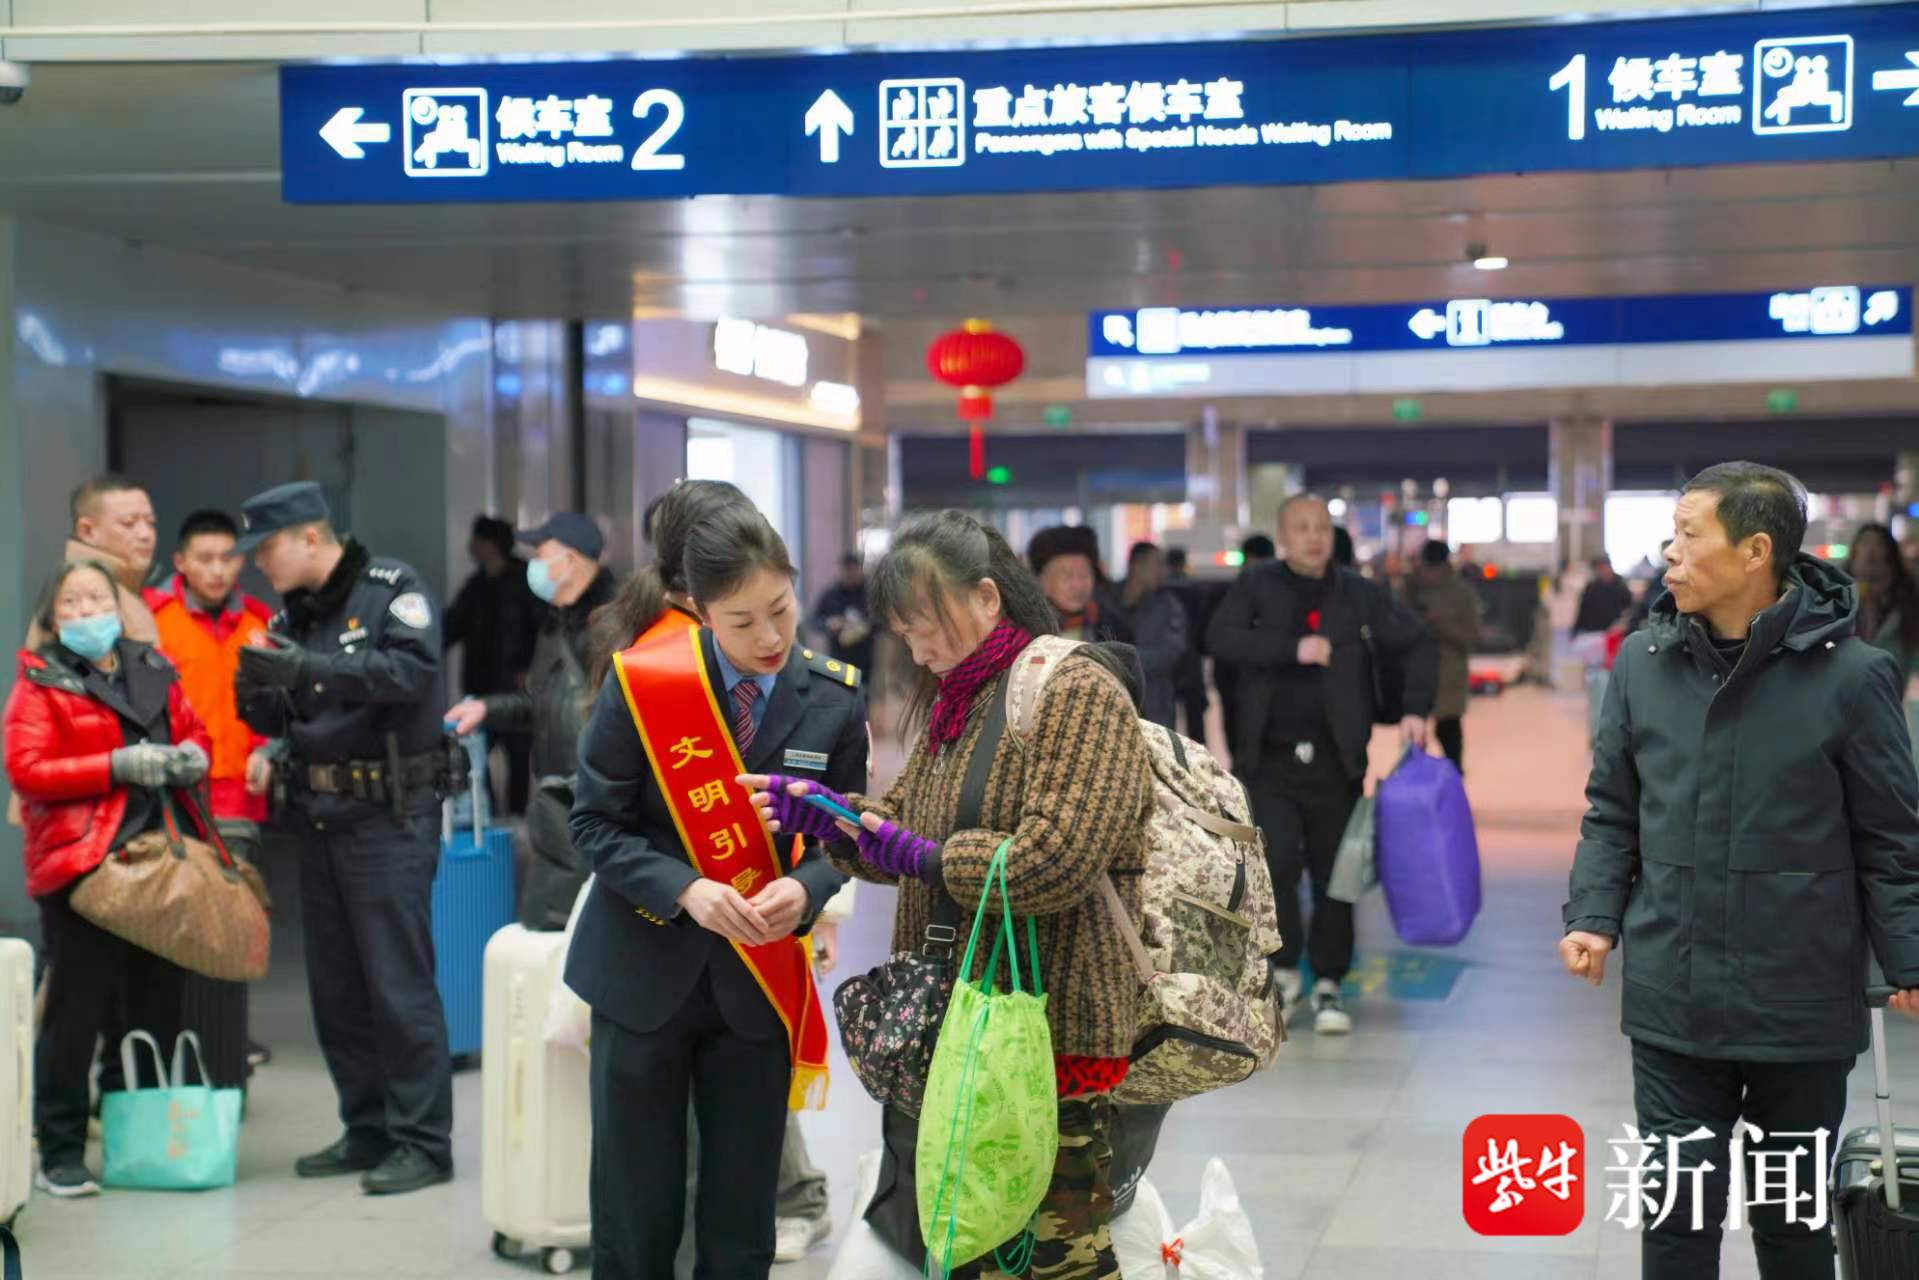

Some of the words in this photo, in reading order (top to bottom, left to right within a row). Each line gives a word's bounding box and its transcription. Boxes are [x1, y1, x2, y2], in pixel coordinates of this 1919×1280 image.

[1549, 54, 1586, 140] 1
[1608, 51, 1743, 102] 候车室
[496, 94, 613, 139] 候车室
[973, 76, 1244, 127] 重点旅客候车室
[1594, 106, 1674, 132] Waiting
[1676, 103, 1742, 127] Room
[631, 88, 685, 170] 2
[1125, 125, 1194, 152] Special
[1261, 121, 1331, 147] Waiting
[1333, 120, 1392, 142] Room
[496, 142, 566, 168] Waiting
[566, 141, 623, 163] Room
